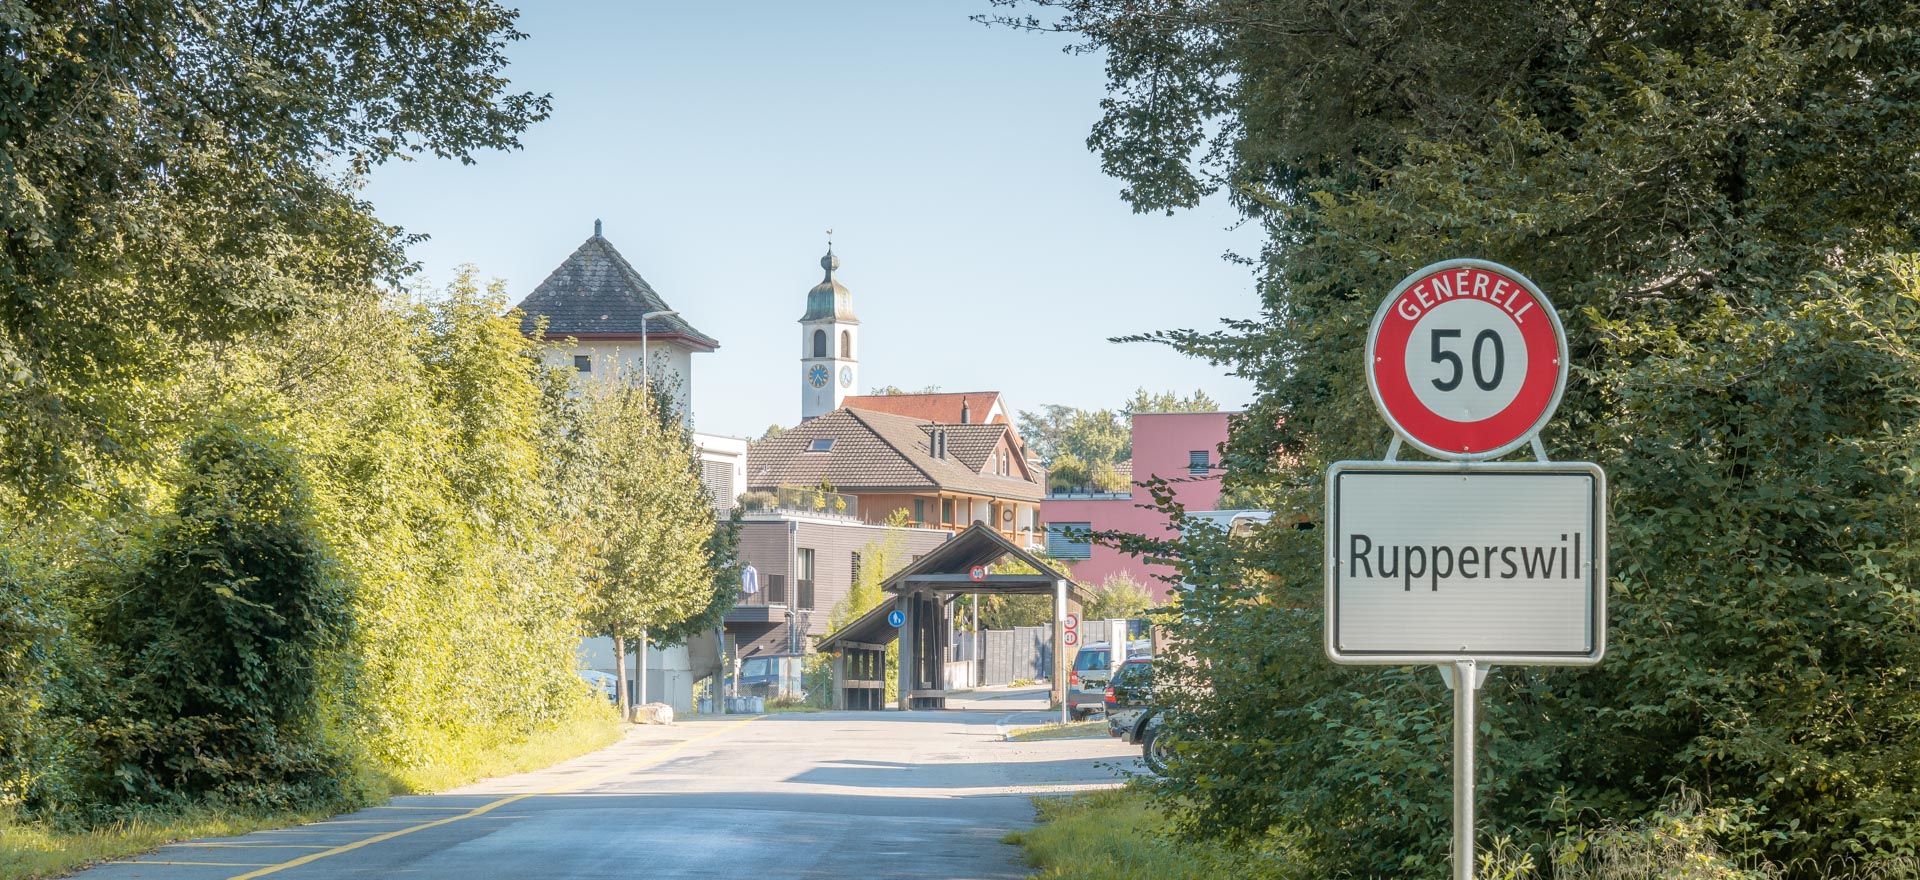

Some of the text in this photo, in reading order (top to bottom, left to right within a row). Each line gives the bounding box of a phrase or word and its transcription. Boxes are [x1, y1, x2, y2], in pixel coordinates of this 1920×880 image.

[1398, 270, 1534, 324] GENERELL
[1430, 328, 1504, 392] 50
[1350, 533, 1581, 592] Rupperswil
